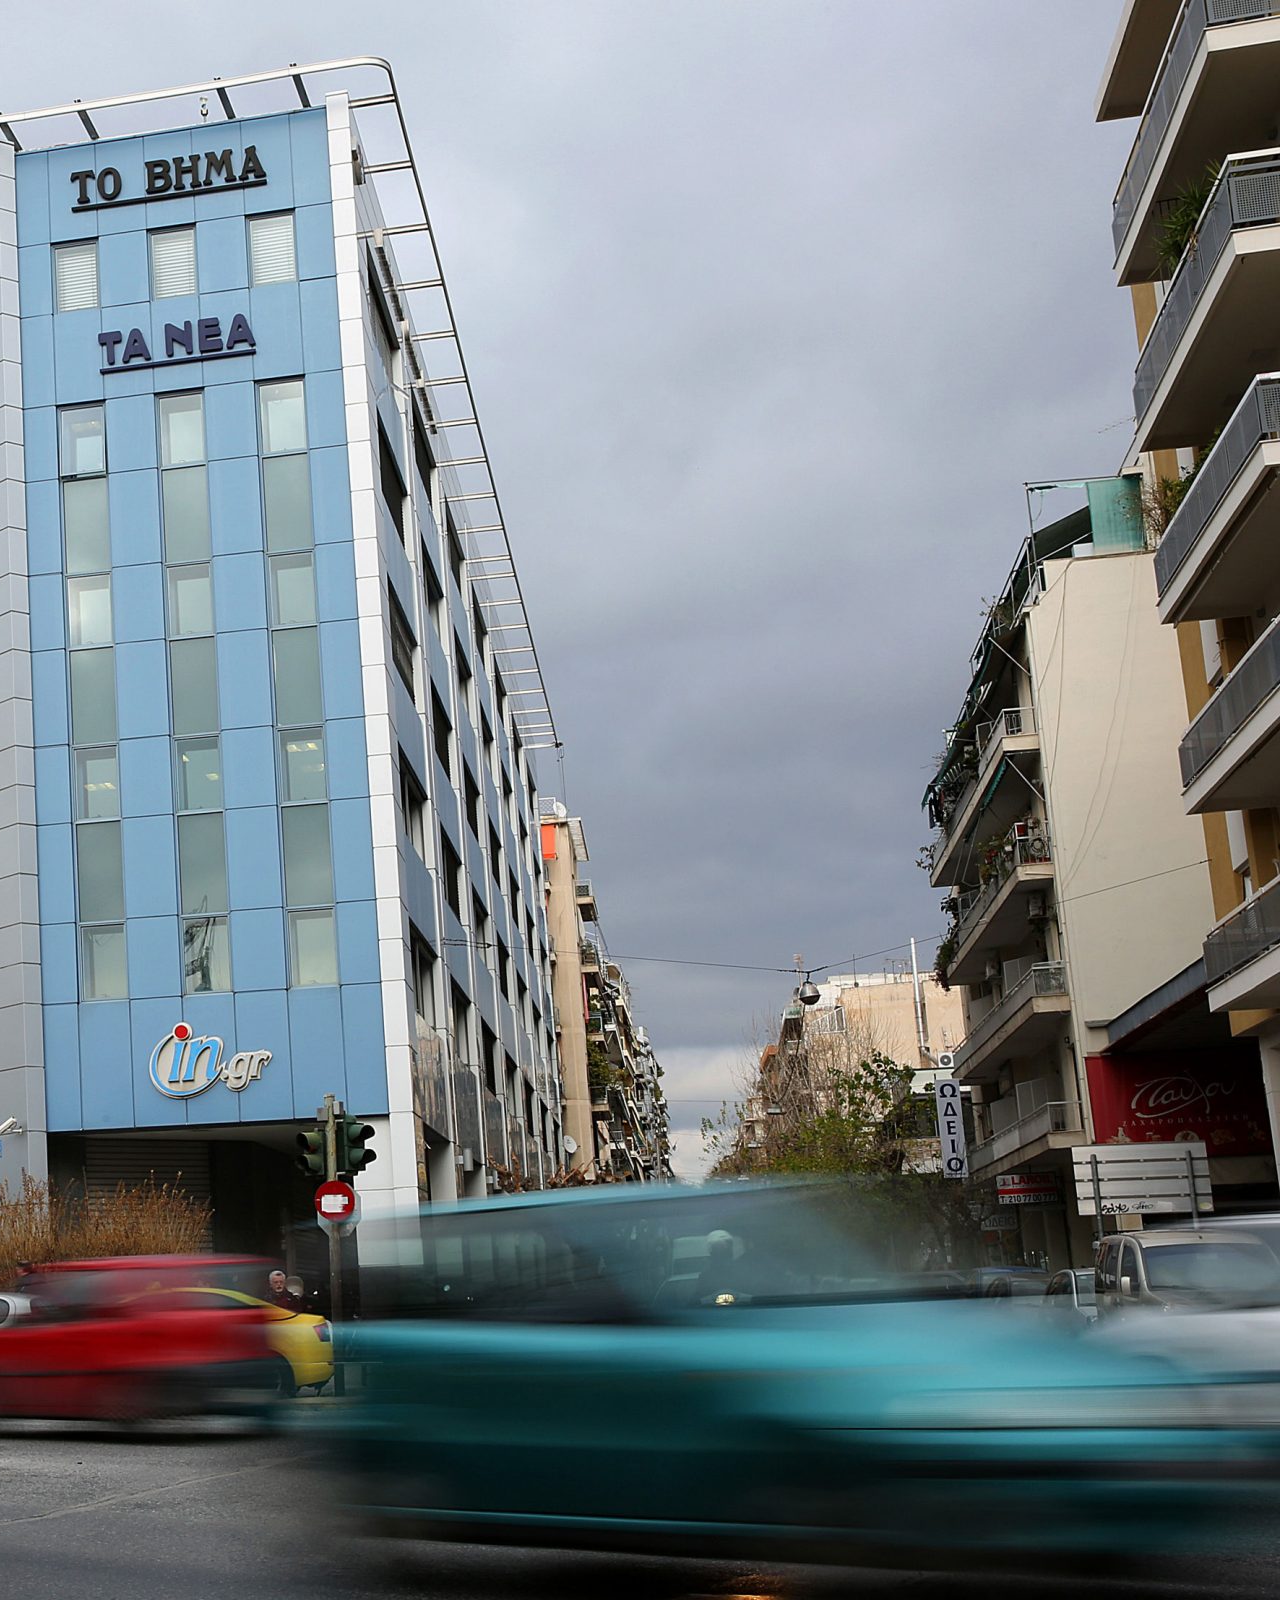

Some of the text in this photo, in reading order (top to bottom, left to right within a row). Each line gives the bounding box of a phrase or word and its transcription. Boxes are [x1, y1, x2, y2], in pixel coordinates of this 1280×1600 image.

[70, 145, 266, 204] ΤΟ ΒΗΜΑ
[98, 313, 256, 365] ΤΑ ΝΕΑ
[940, 1083, 964, 1172] ΩΔΕΙΟ
